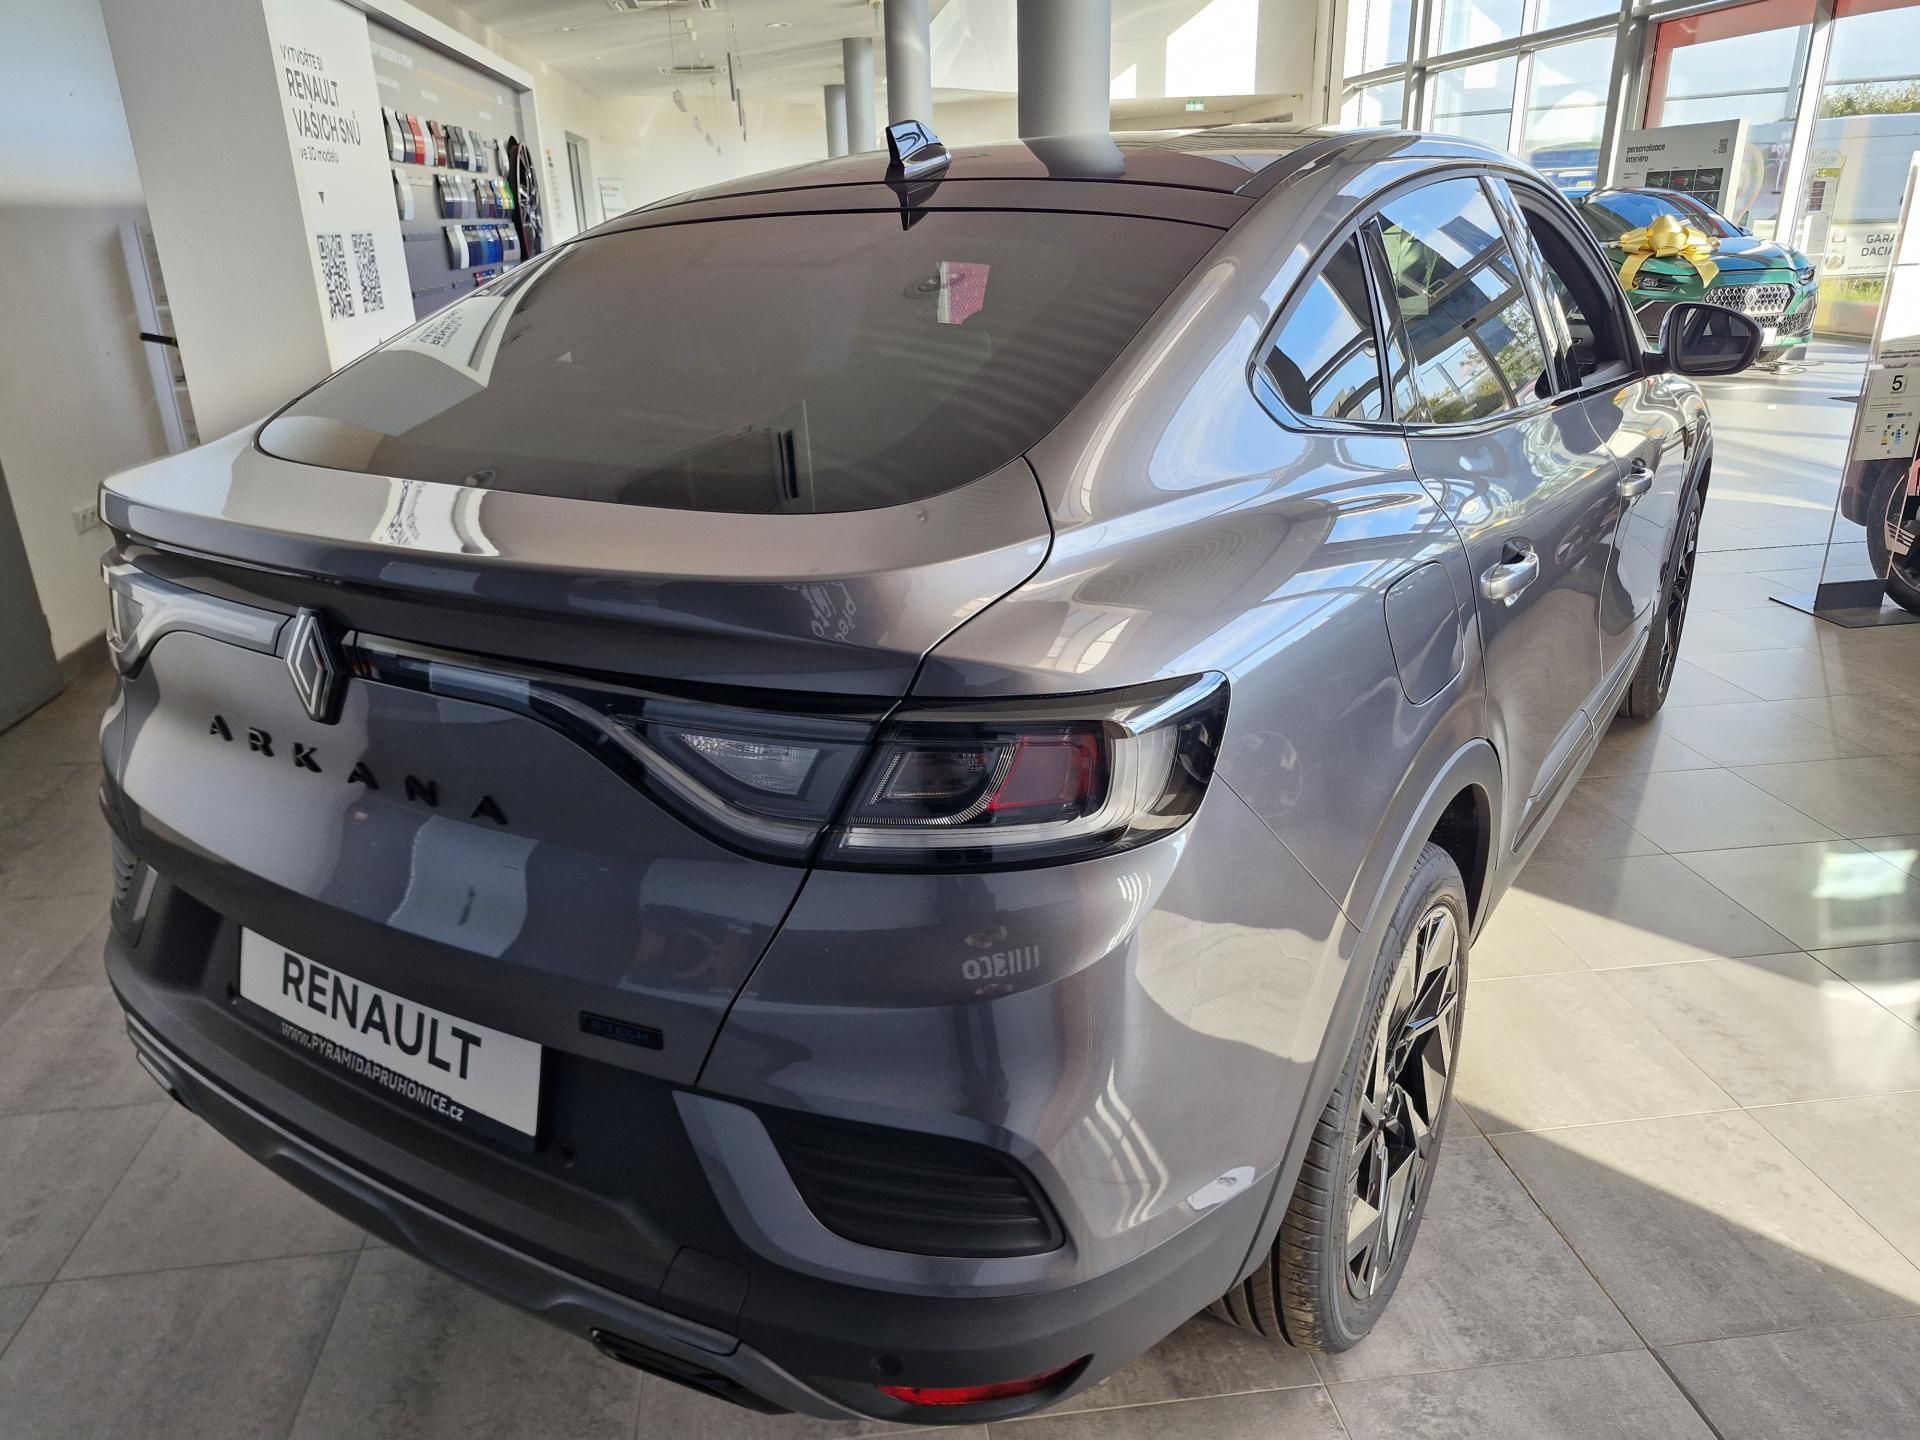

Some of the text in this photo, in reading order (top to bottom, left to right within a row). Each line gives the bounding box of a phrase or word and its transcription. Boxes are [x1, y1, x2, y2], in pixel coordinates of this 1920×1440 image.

[280, 43, 317, 70] VYTVOŘTE
[285, 66, 339, 107] RENAULT
[292, 102, 361, 146] VAŠICH SNŮ
[1625, 153, 1649, 163] interiéru
[1626, 143, 1666, 157] personalizace
[1891, 375, 1904, 391] 5
[209, 715, 509, 825] ARKANA
[282, 952, 482, 1080] RENAULT
